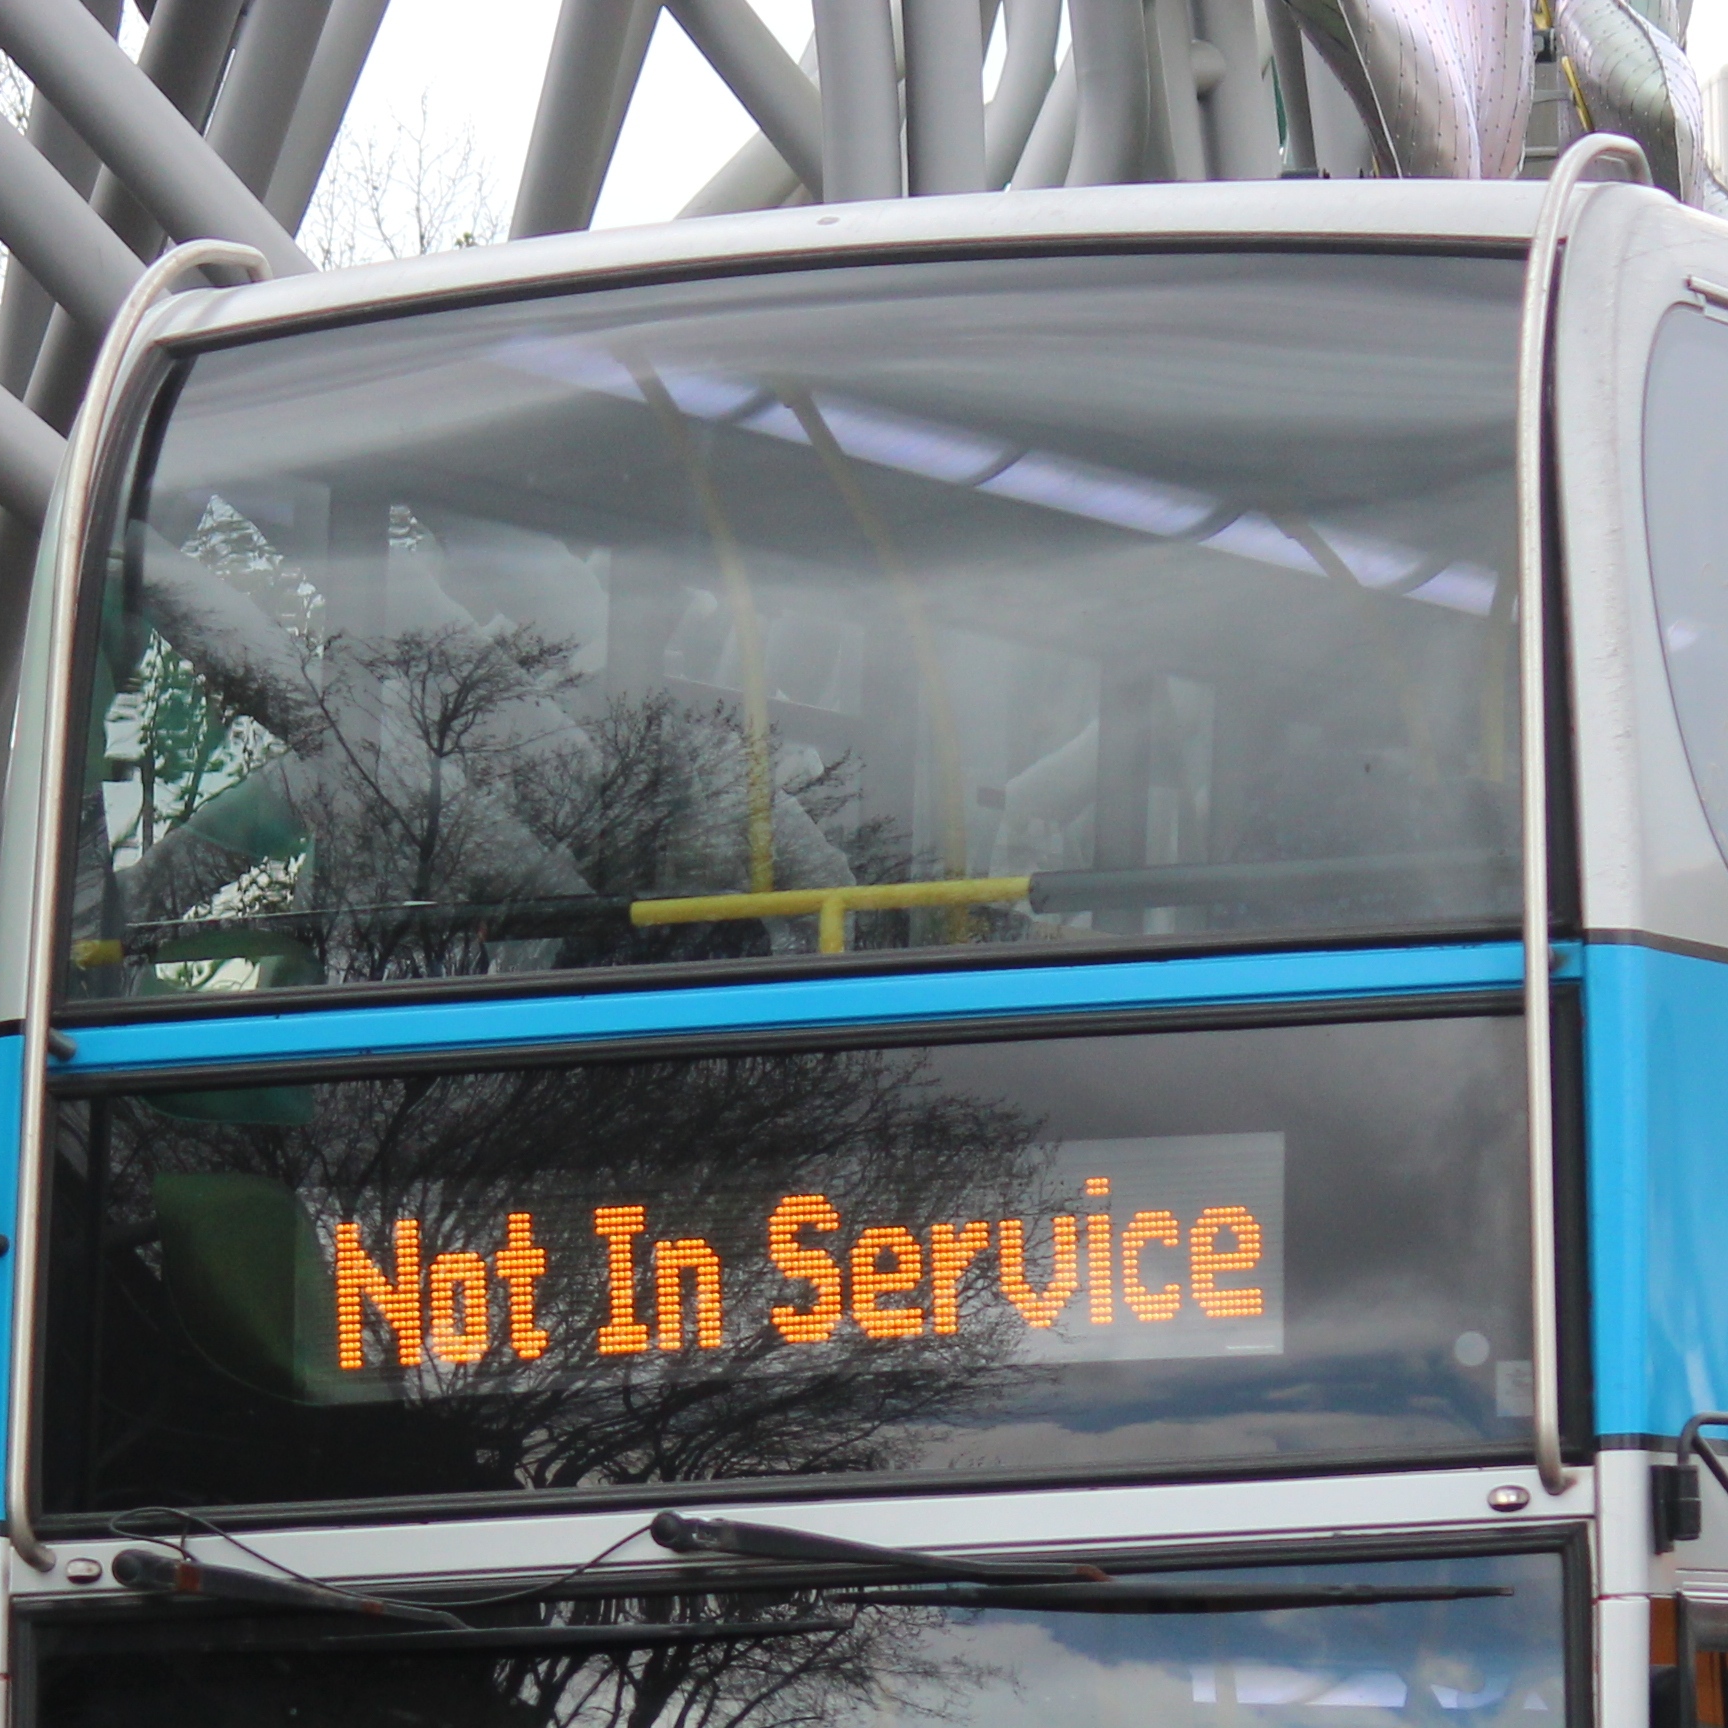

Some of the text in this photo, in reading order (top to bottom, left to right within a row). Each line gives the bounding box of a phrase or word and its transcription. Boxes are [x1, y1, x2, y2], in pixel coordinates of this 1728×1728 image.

[334, 1176, 1265, 1371] Not In Service
